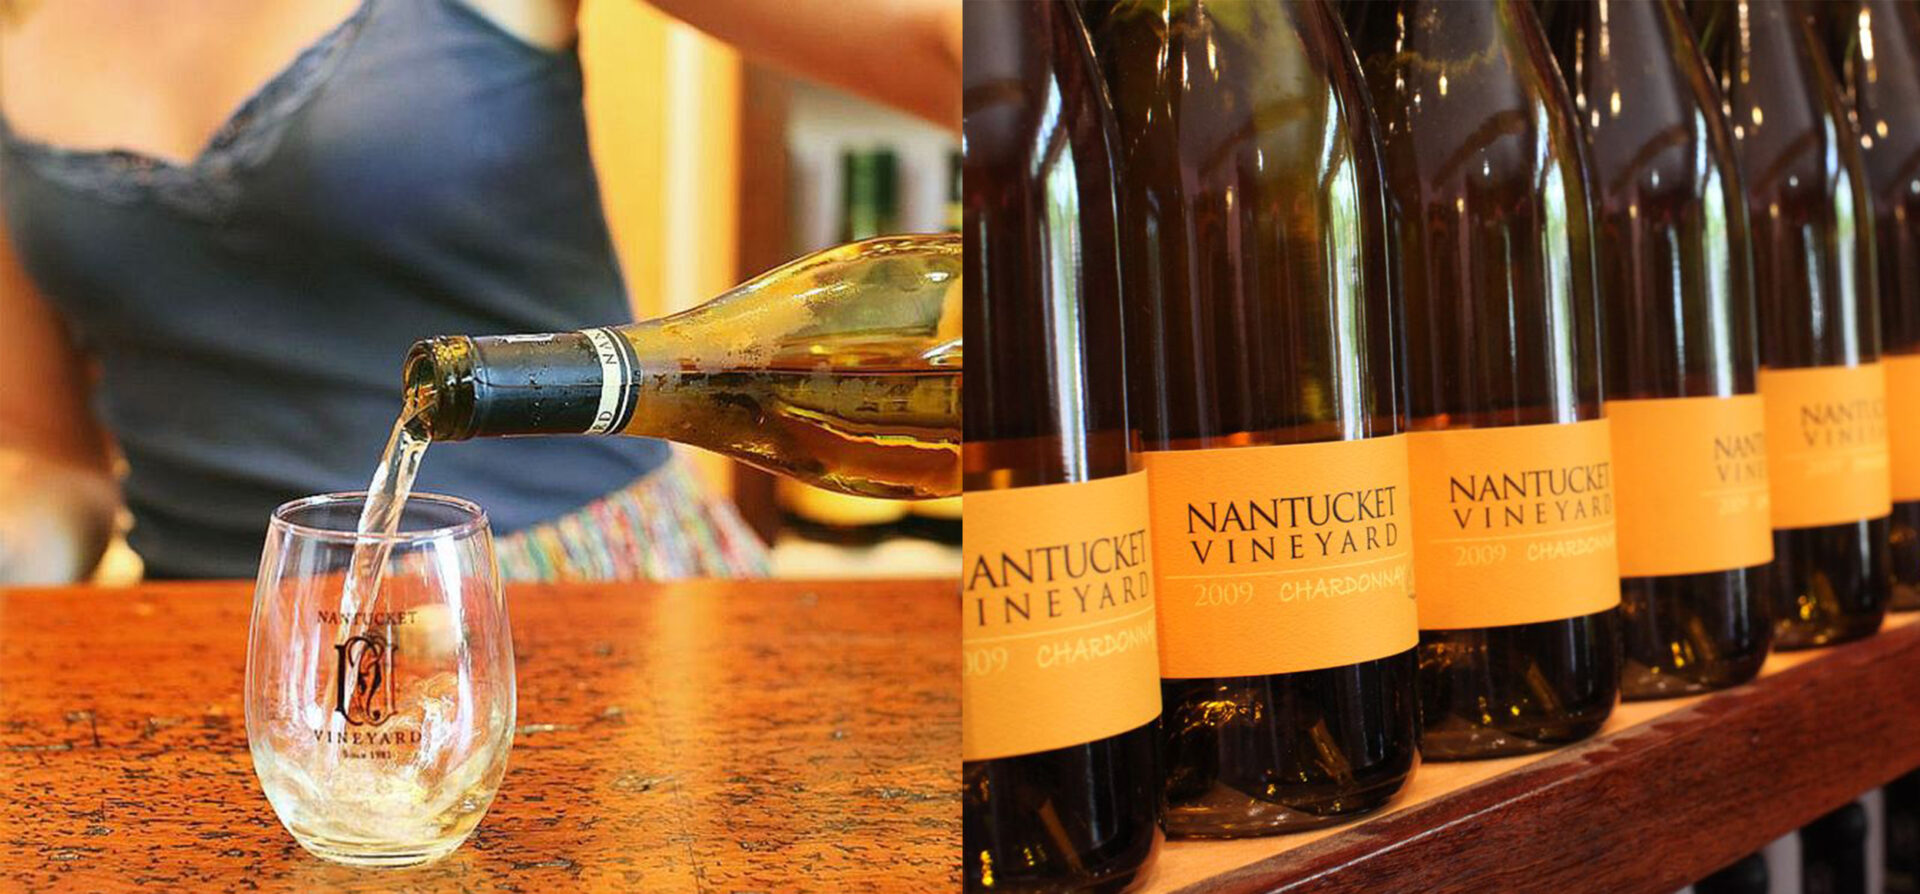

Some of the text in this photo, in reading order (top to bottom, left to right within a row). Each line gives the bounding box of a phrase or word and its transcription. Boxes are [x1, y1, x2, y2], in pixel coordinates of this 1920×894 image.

[1450, 462, 1609, 503] NANTUCKET
[1187, 486, 1396, 534] NANTUCKET
[1454, 493, 1612, 529] VINEYARD
[1191, 522, 1398, 564] VINEYARD
[1455, 543, 1506, 567] 2009
[1194, 564, 1407, 607] 2009 CHARDONNAY
[317, 610, 417, 626] NANTUCKET
[314, 728, 422, 745] VINEYARD
